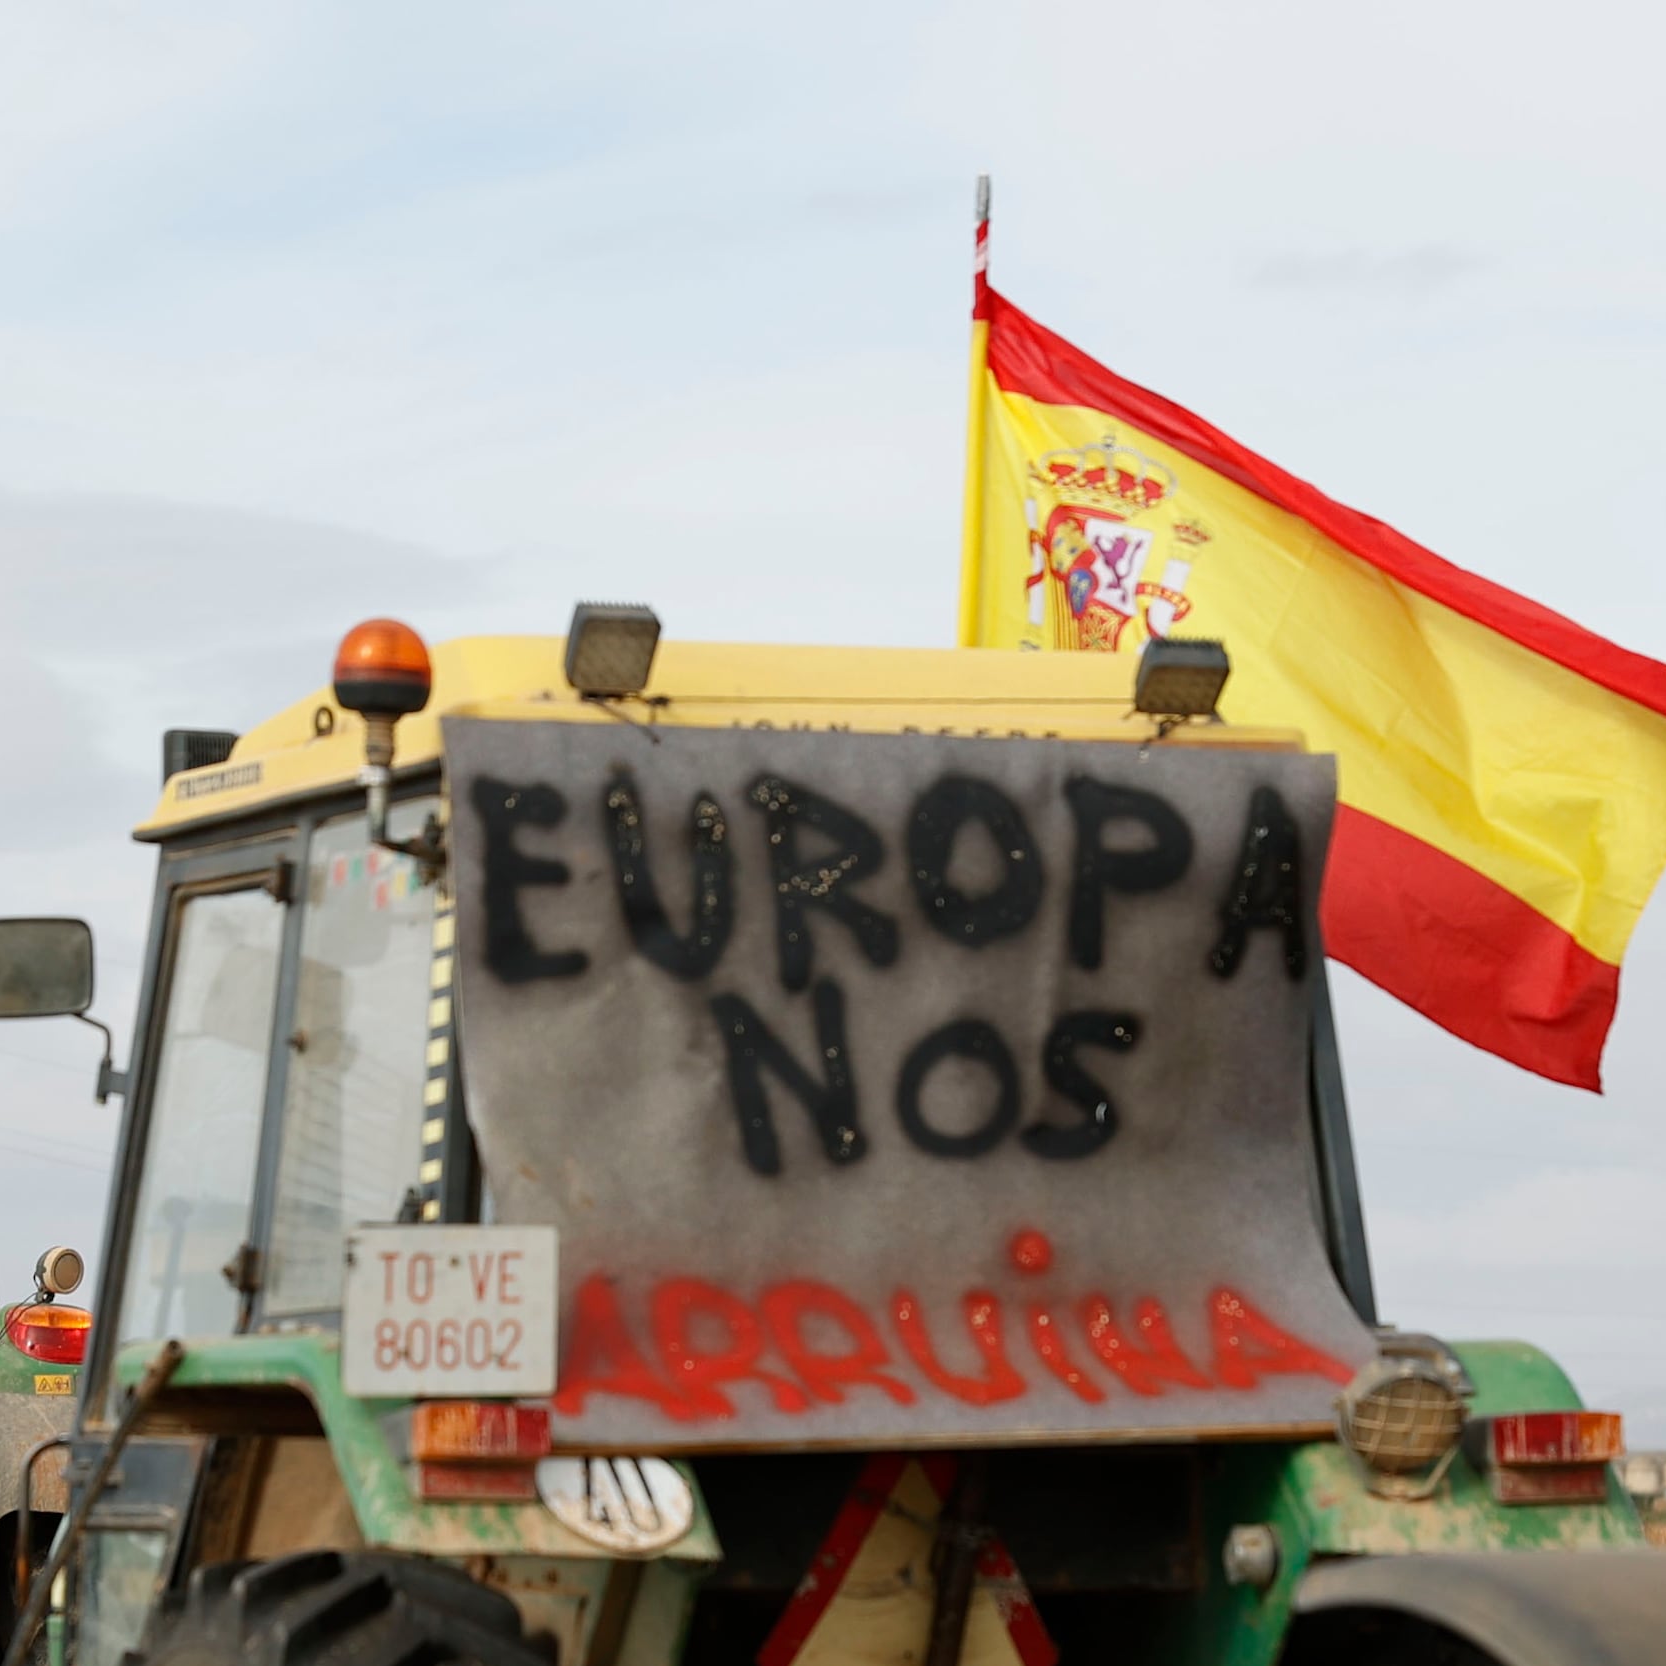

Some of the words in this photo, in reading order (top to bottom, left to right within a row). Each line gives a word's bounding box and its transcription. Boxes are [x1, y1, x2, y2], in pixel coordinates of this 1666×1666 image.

[468, 763, 1309, 992] EUROPA
[705, 974, 1145, 1176] NOS
[377, 1251, 435, 1305] TO
[467, 1251, 524, 1306] VE
[374, 1317, 523, 1372] 80602
